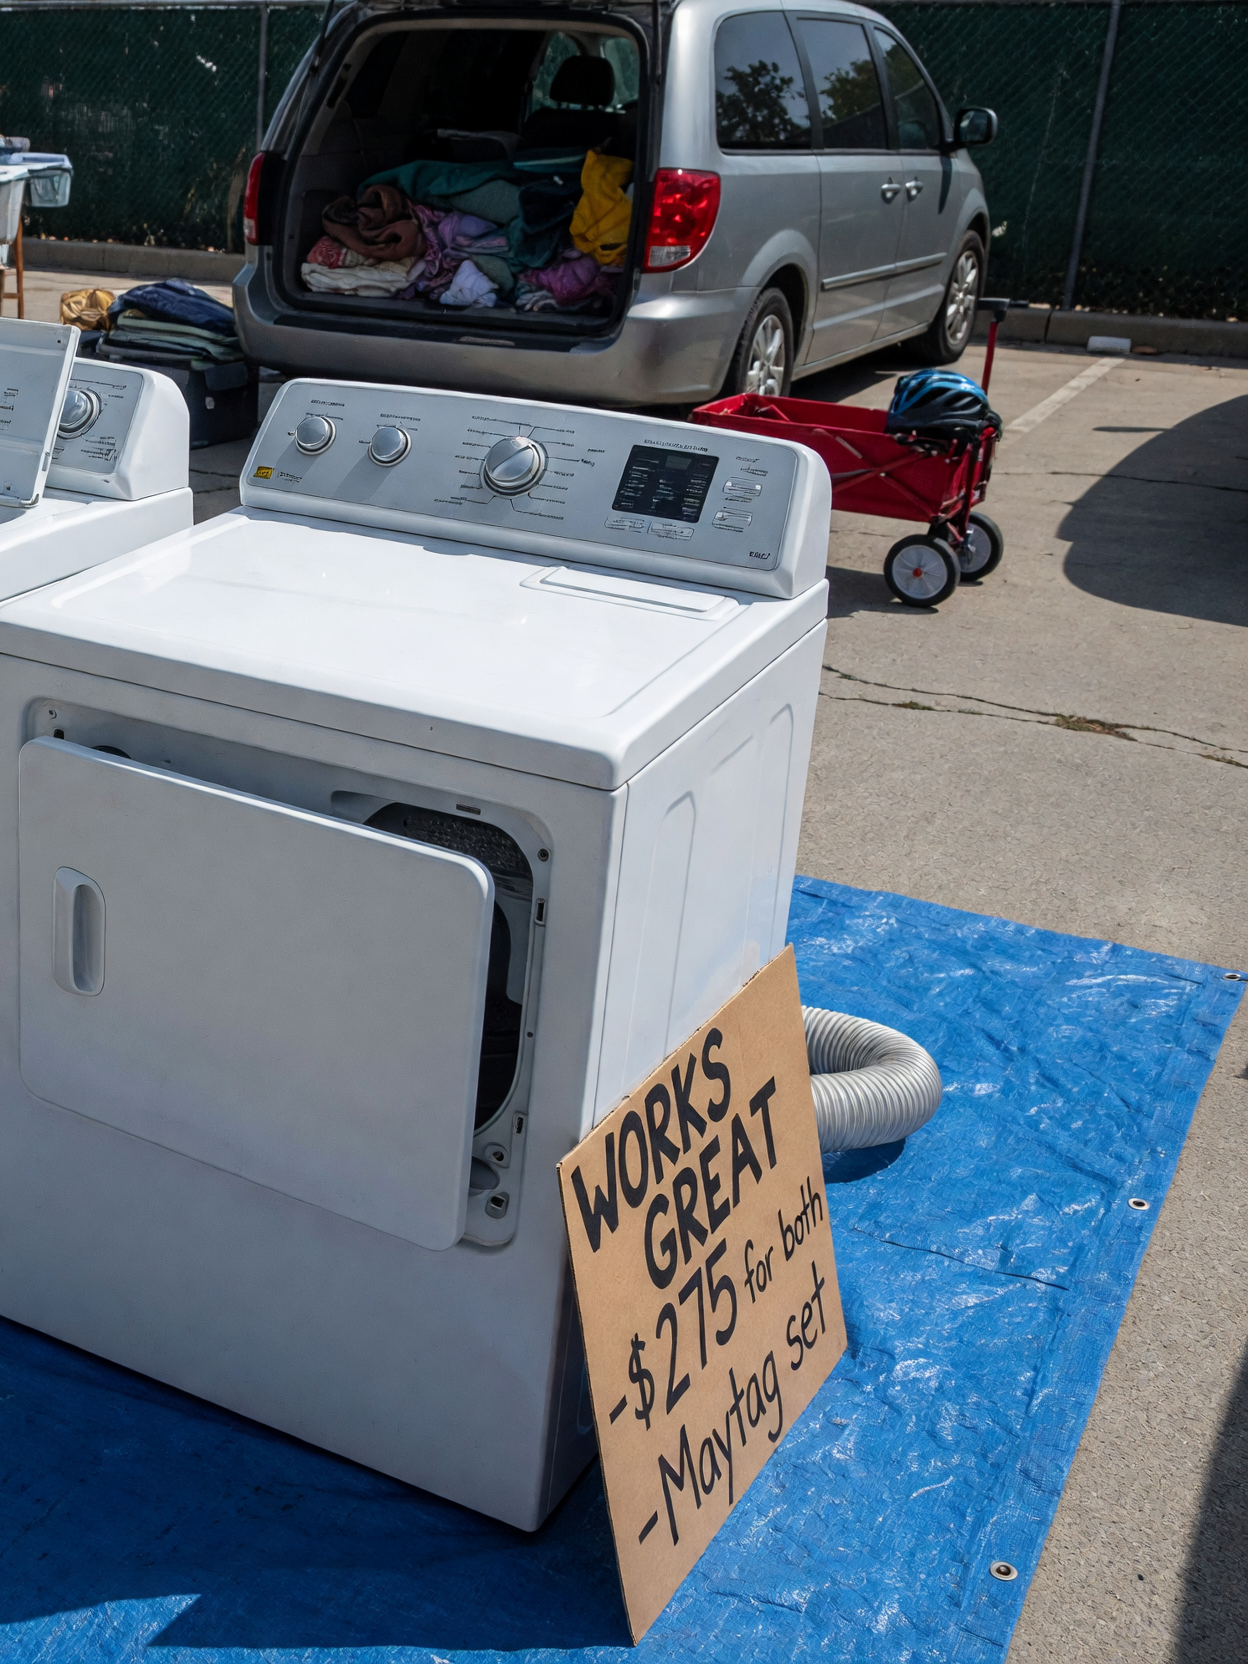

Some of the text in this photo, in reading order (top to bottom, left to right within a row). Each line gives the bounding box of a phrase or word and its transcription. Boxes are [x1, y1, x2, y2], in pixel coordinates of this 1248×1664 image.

[570, 1027, 732, 1253] WORKS
[643, 1076, 778, 1289] GREAT
[744, 1238, 774, 1304] for
[778, 1175, 824, 1262] both
[786, 1259, 826, 1371] set
